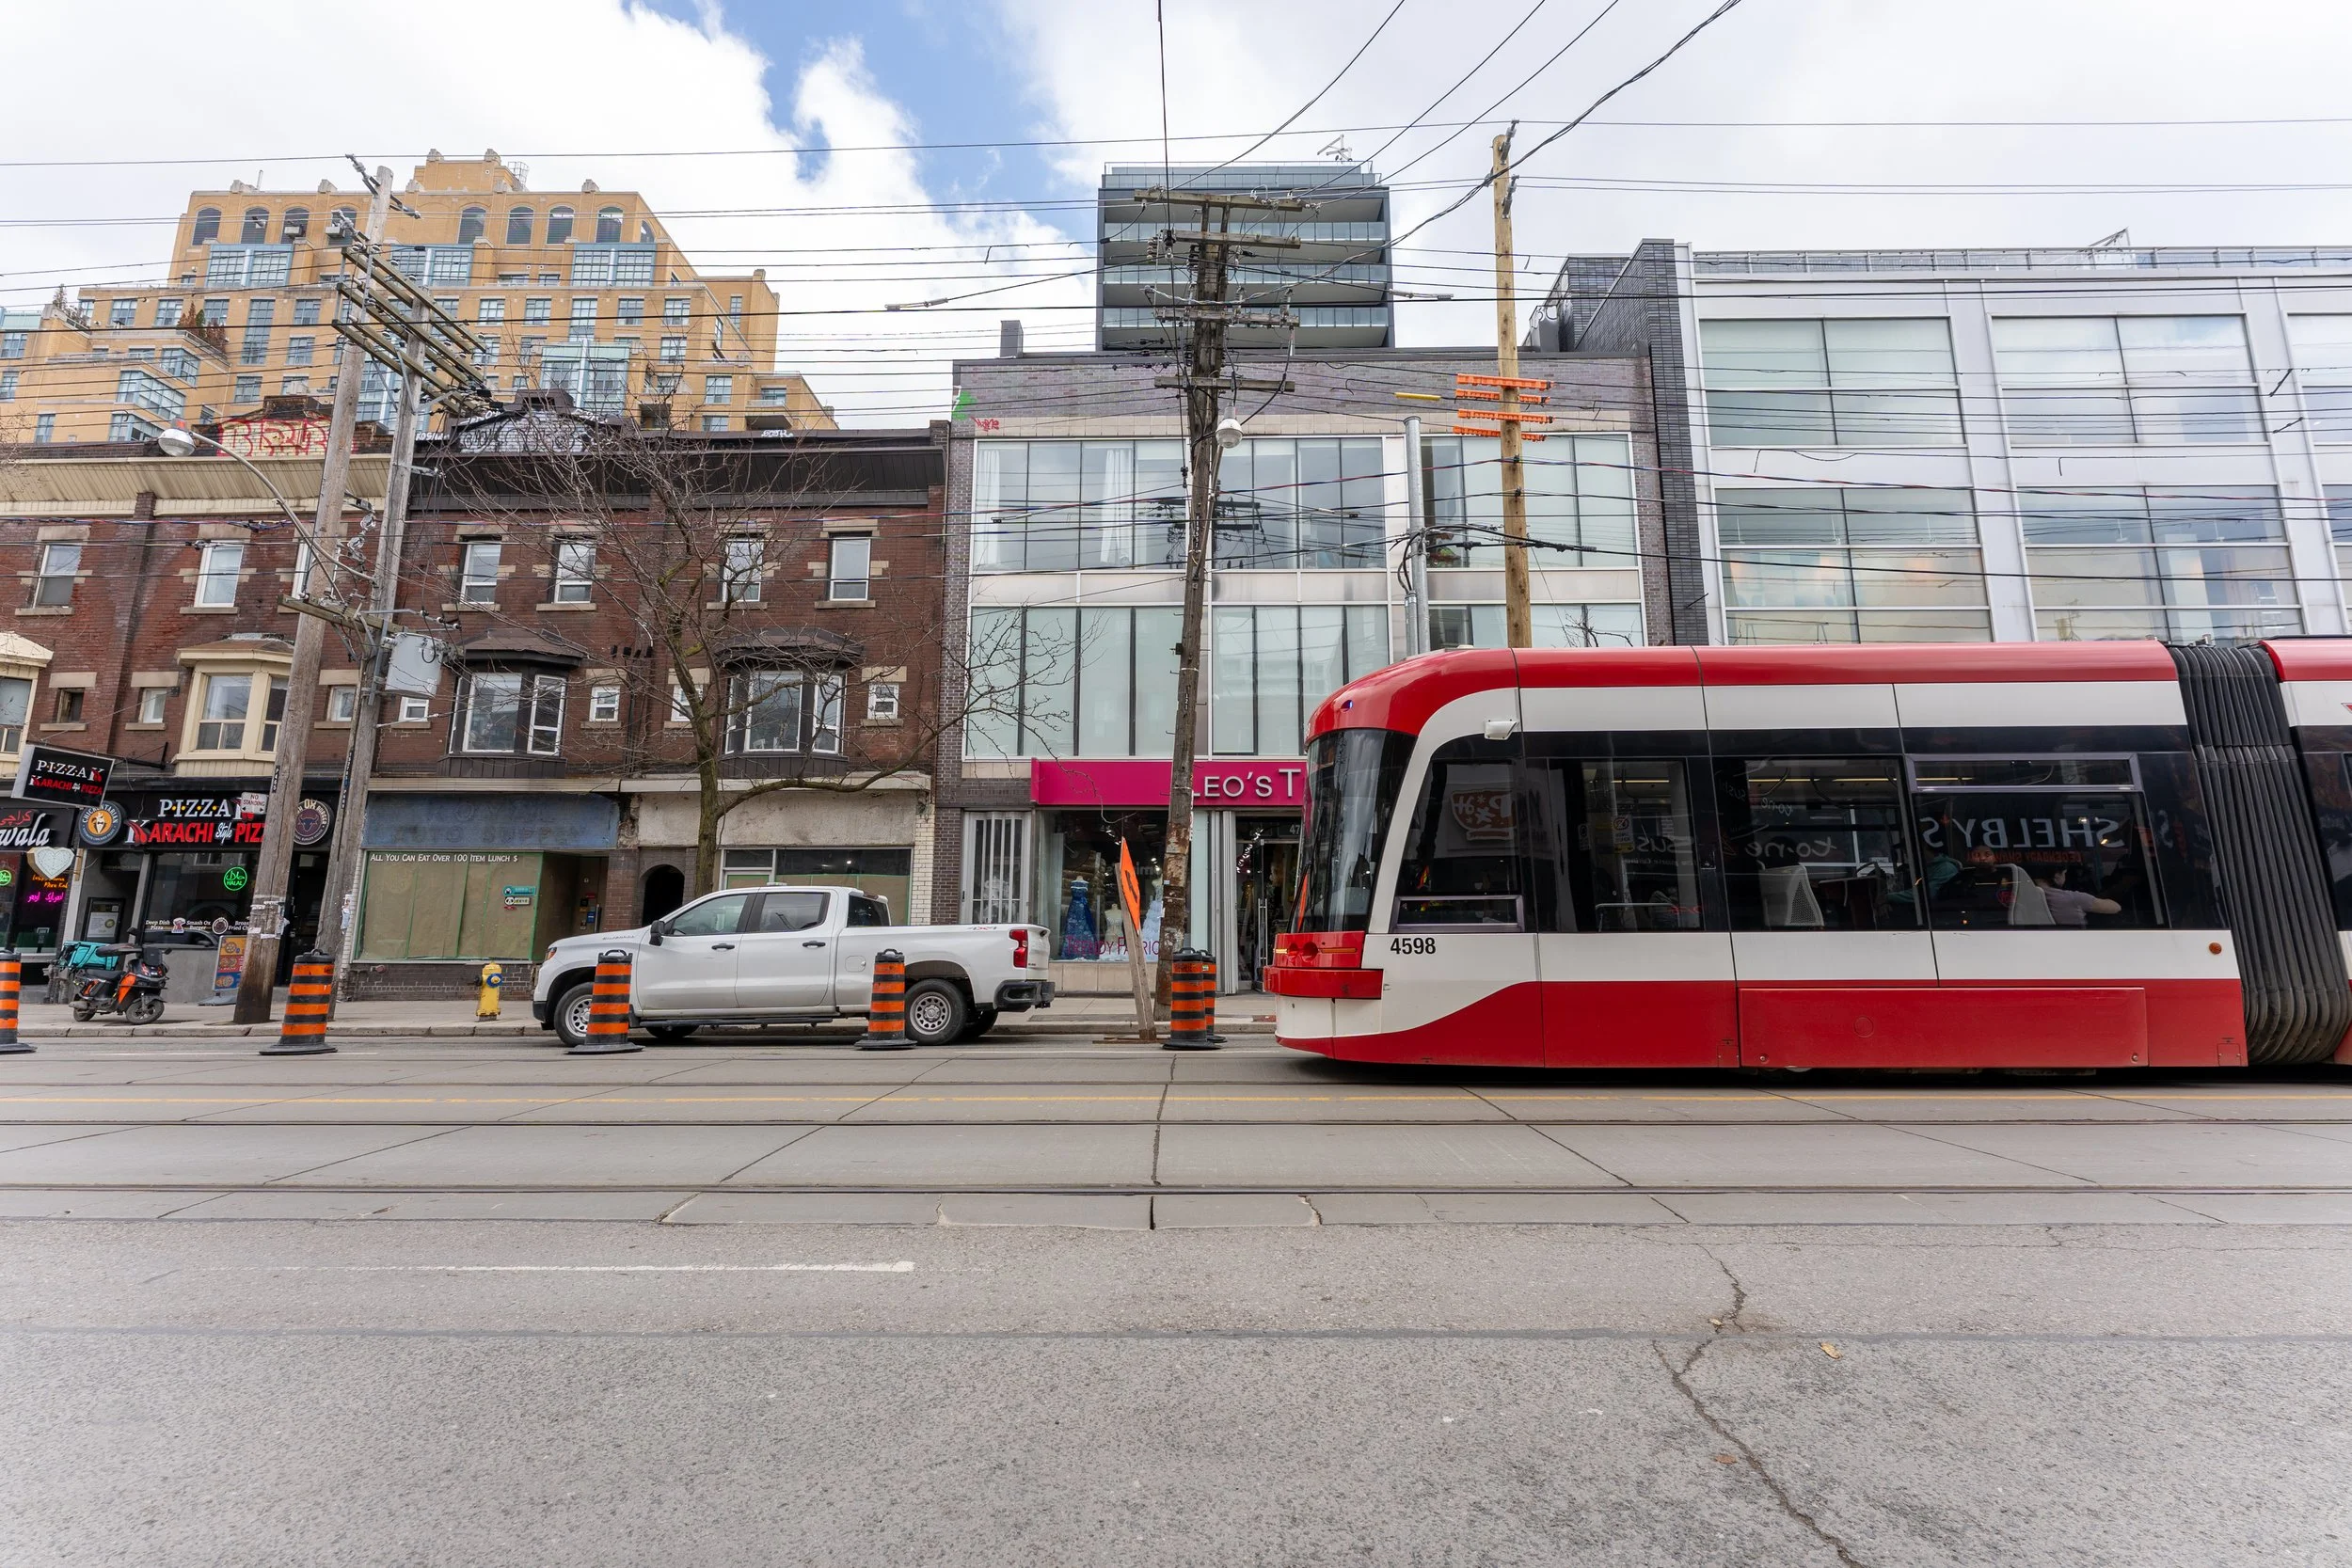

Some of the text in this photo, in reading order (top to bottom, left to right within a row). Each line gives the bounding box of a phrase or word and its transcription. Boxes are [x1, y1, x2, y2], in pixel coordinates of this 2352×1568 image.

[28, 775, 72, 791] KARACHI
[81, 784, 103, 796] PIZZA
[1193, 772, 1273, 798] EO'S
[157, 799, 231, 817] PIZZA
[304, 799, 318, 810] OX
[124, 819, 215, 844] KARACHI
[234, 822, 267, 843] PIZ
[453, 854, 468, 863] 100
[513, 854, 518, 863] $
[1118, 936, 1160, 956] FARIC
[1390, 937, 1437, 955] 4598
